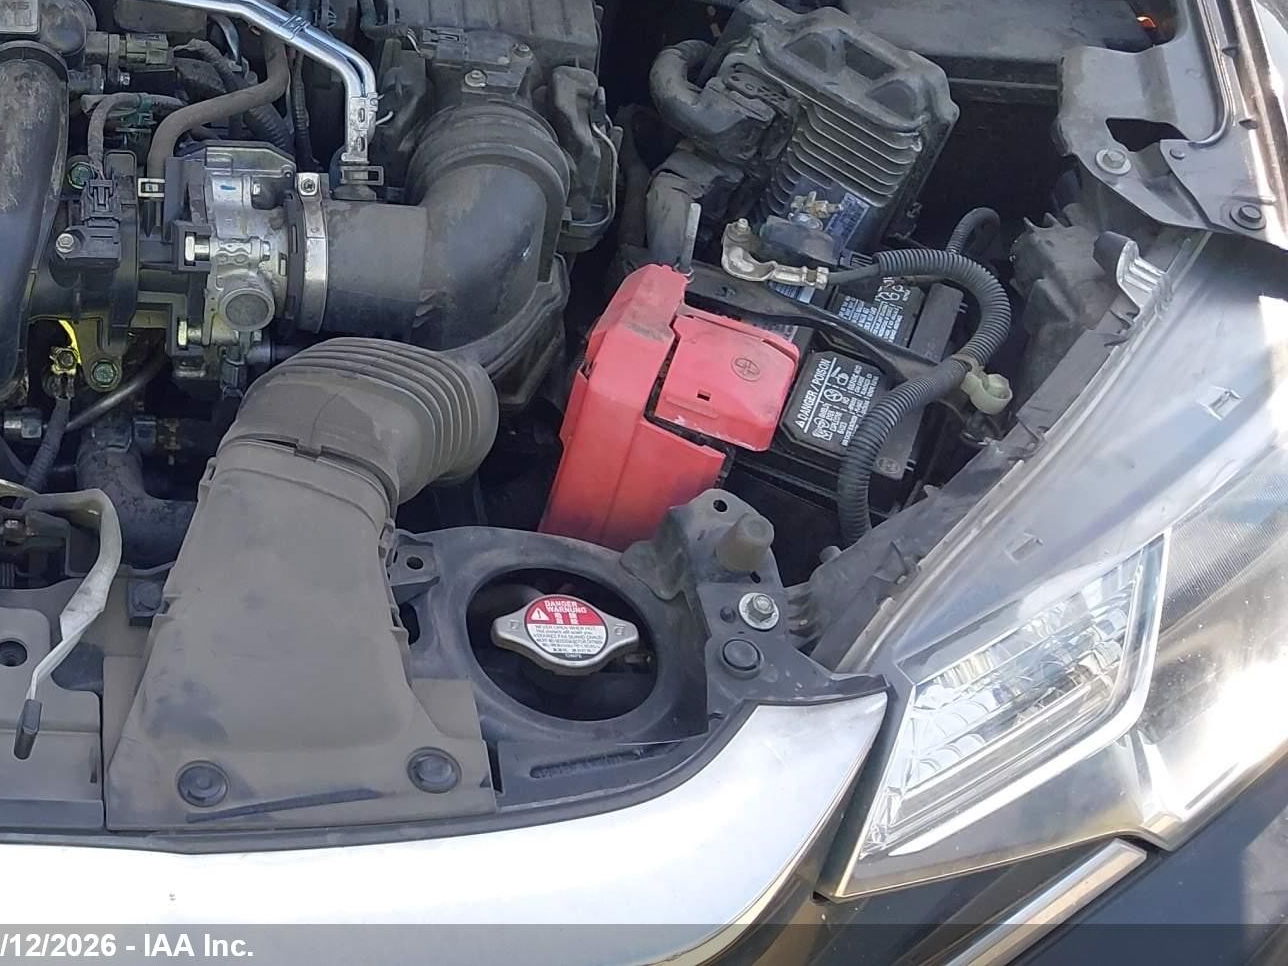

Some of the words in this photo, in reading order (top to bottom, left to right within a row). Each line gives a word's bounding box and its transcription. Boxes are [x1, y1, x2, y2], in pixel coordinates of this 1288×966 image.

[796, 390, 817, 422] DANGER
[811, 358, 831, 386] POISON
[544, 600, 577, 608] DANGER
